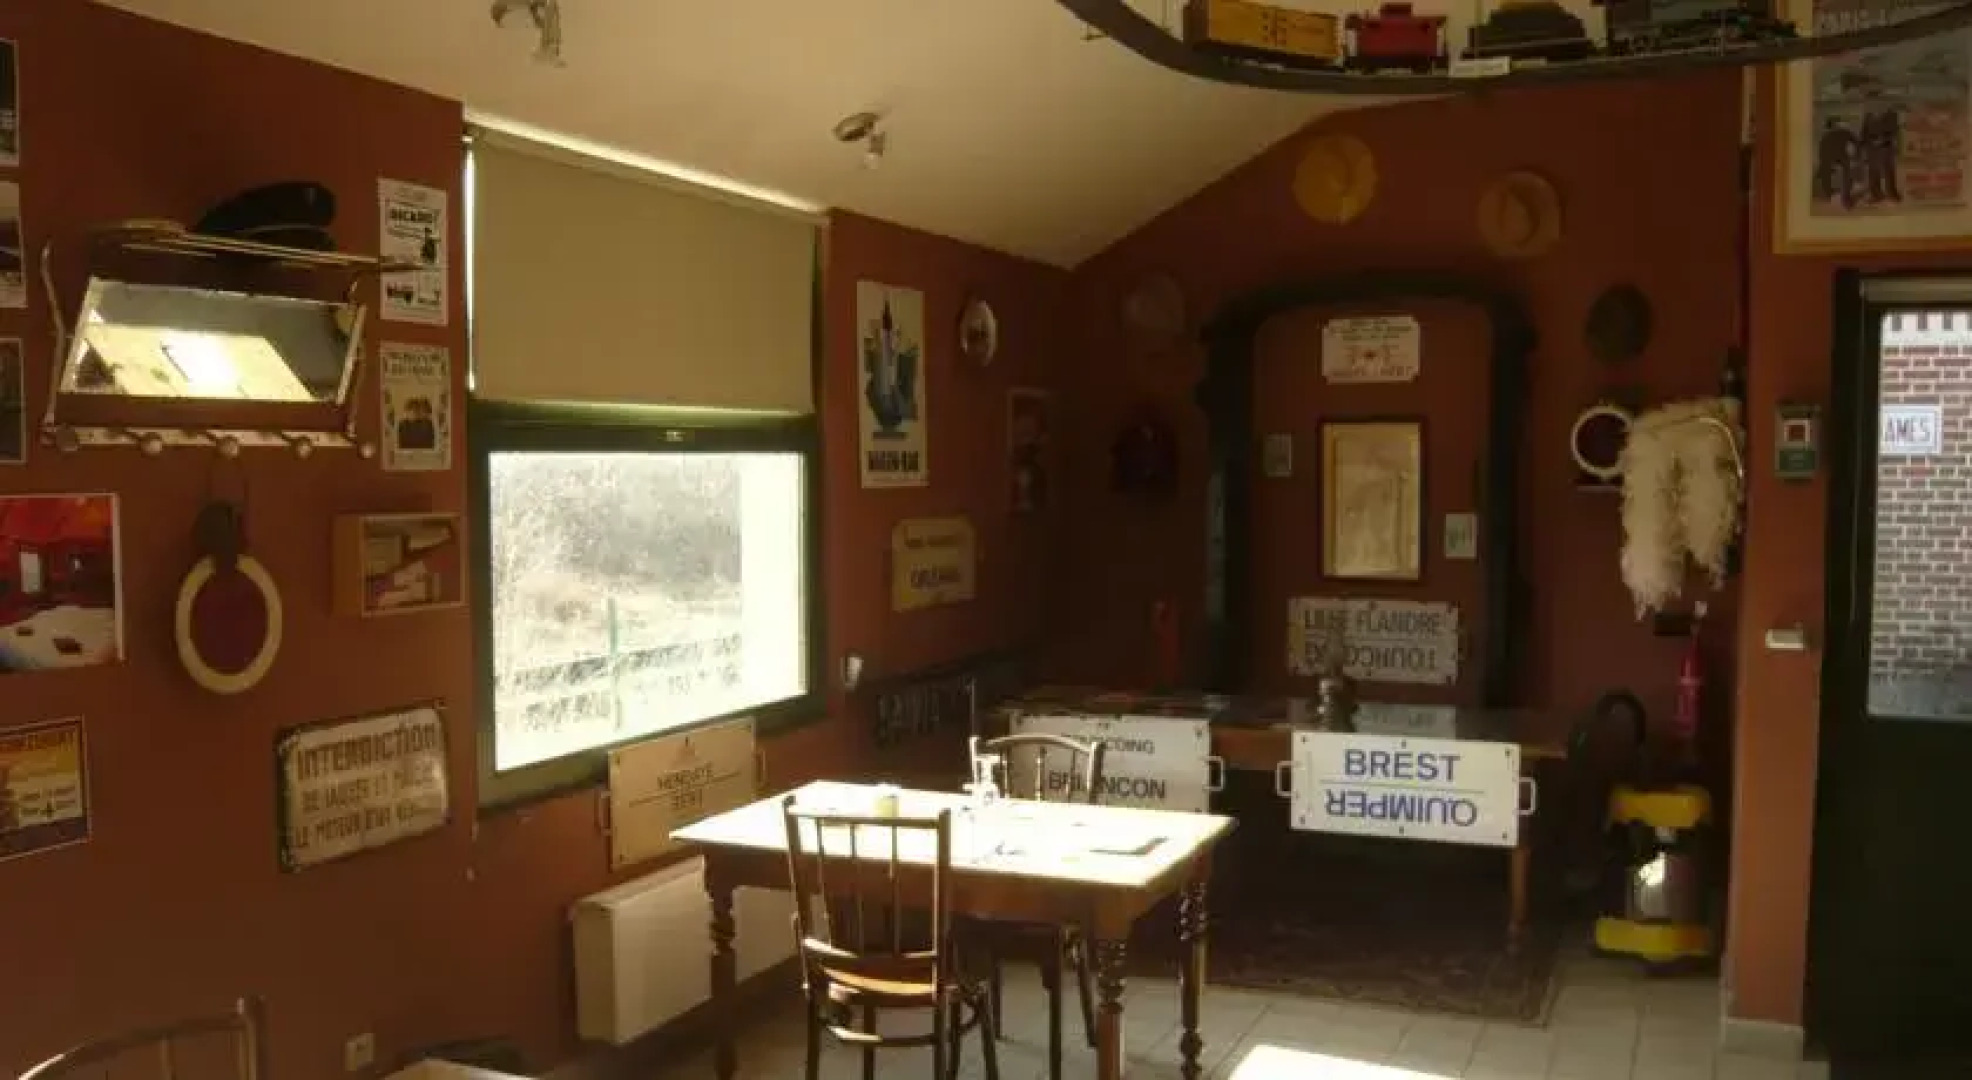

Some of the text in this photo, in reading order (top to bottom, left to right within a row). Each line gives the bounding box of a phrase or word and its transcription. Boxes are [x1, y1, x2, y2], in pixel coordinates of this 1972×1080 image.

[1884, 416, 1931, 443] AMES
[297, 722, 437, 781] INTERDICTION
[1343, 749, 1462, 783] BREST
[1325, 788, 1478, 827] QUIMPER
